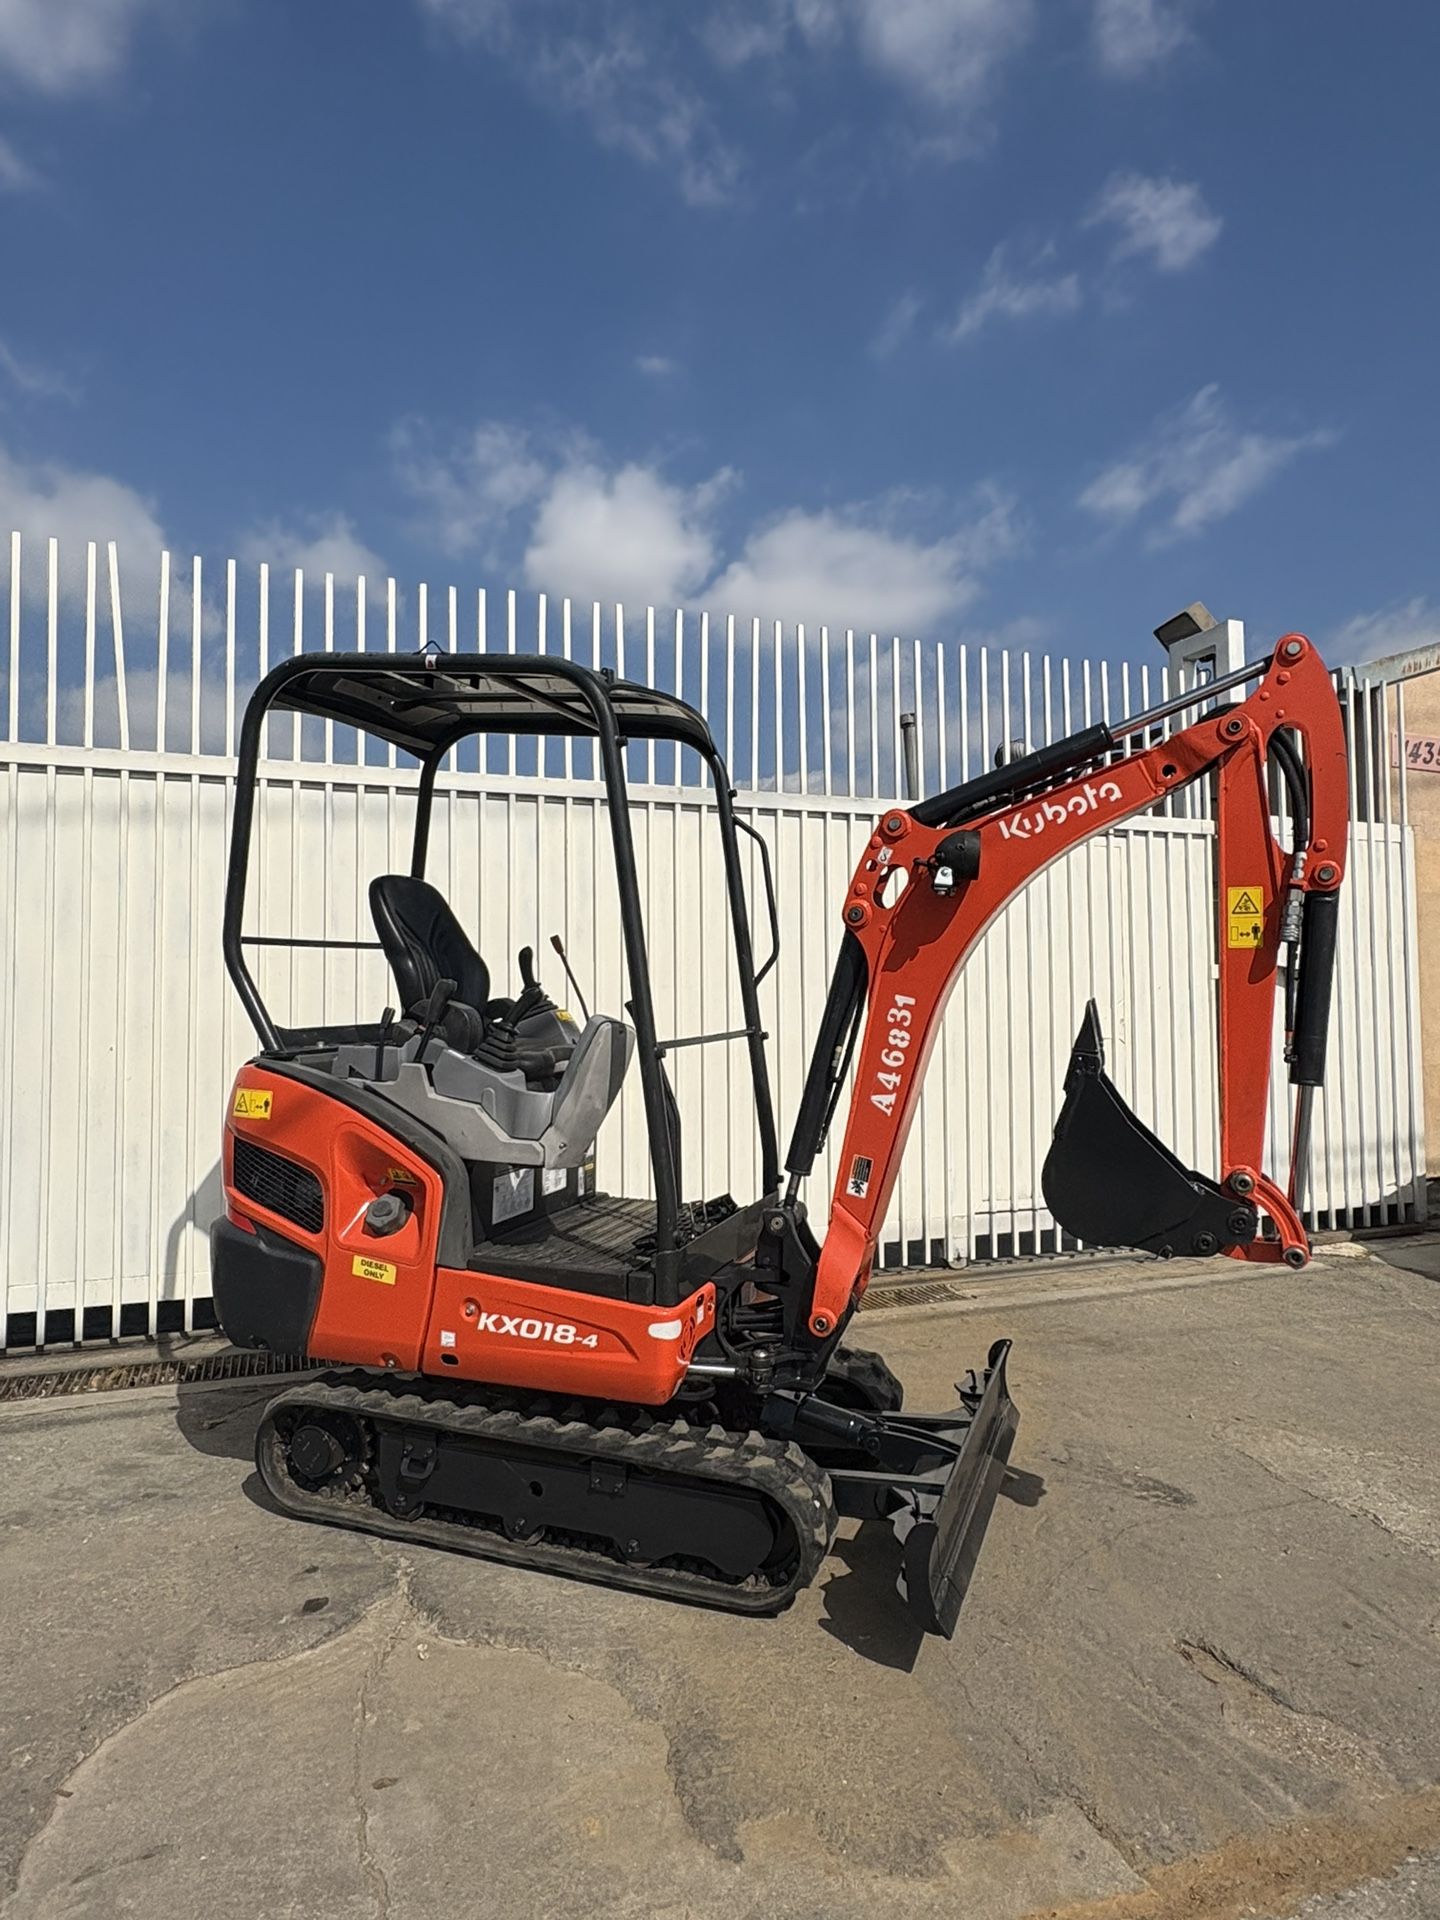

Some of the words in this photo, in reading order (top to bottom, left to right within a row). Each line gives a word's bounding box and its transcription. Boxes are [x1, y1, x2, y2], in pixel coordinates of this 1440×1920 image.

[998, 782, 1123, 840] Kubota
[870, 994, 916, 1117] A46831
[360, 1259, 389, 1272] DIESEL
[363, 1268, 384, 1280] ONLY
[477, 1312, 598, 1348] KX018-4
